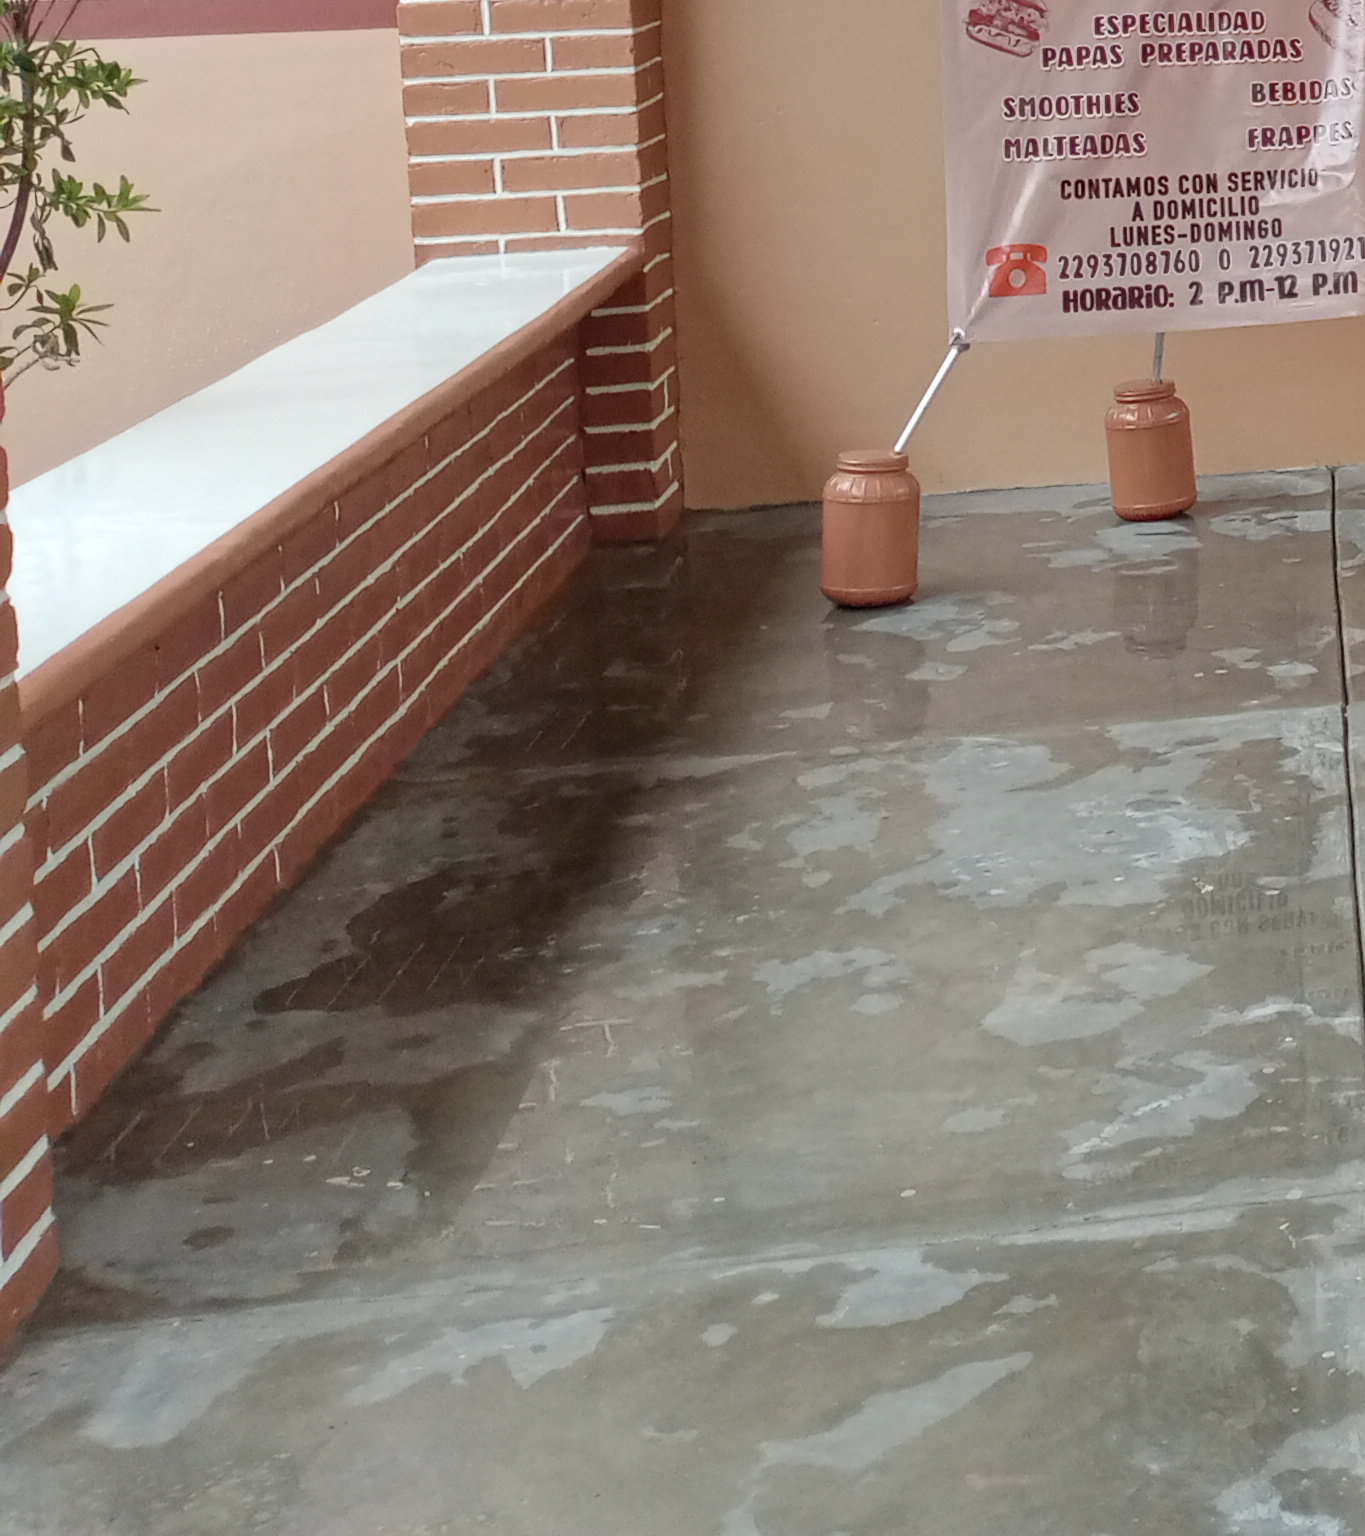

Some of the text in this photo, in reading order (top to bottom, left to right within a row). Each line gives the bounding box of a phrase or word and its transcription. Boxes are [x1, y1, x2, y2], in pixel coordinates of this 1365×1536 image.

[1093, 10, 1267, 37] ESPECIALIDAD
[1040, 38, 1304, 69] PAPAS PREPARADAS
[1250, 77, 1353, 105] BEBIDAS
[1002, 92, 1141, 120] SMOOTHIES
[1003, 132, 1148, 161] MALTEADAS
[1246, 120, 1355, 151] FRAPPES
[1059, 168, 1319, 201] CONTAMOS CON SERVICIO
[1132, 195, 1260, 222] A DOMICILIO
[1110, 217, 1283, 248] LUNES-DOMINGO
[1057, 249, 1201, 280] 2293708760
[1188, 280, 1204, 306] 2
